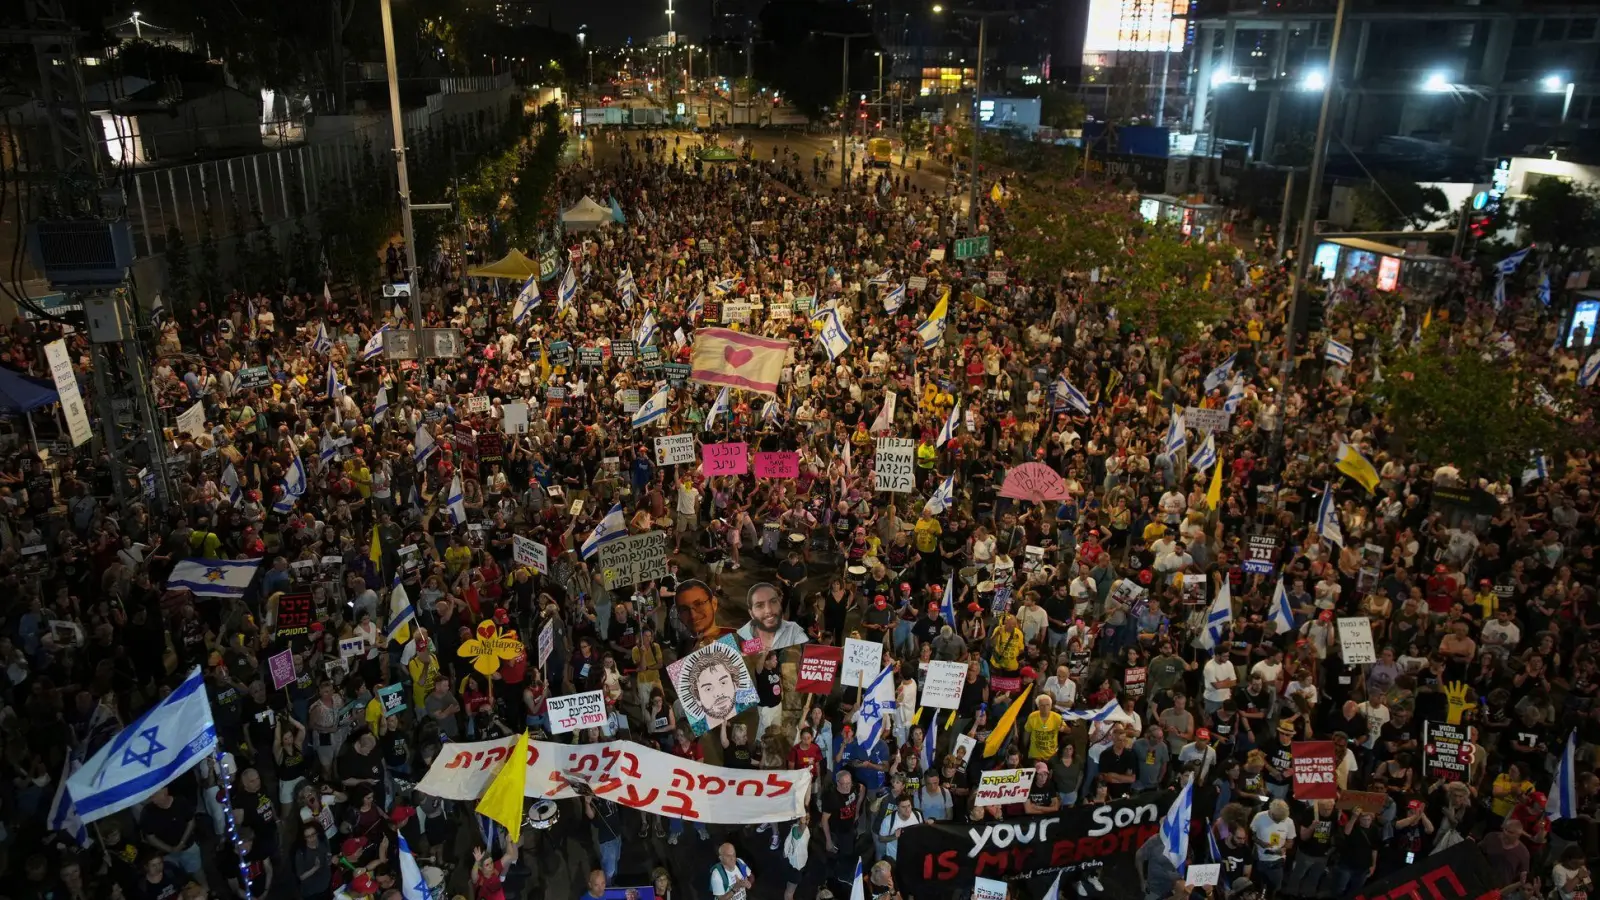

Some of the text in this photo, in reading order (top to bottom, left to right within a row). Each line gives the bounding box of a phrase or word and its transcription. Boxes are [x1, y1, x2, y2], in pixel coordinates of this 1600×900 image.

[1106, 161, 1142, 176] TOWR
[665, 437, 692, 446] הממשלה
[670, 445, 694, 453] הורגת
[712, 445, 741, 457] כולנו
[673, 453, 694, 462] אותנו
[877, 452, 911, 463] ממשלה
[713, 460, 736, 470] עינב
[764, 466, 792, 474] THE REST
[878, 463, 911, 475] בוגדת
[875, 475, 910, 489] בעמה
[1251, 536, 1275, 544] נתניהו
[602, 541, 626, 555] בשם
[1249, 548, 1272, 559] נגד
[517, 552, 545, 570] הביתה
[602, 554, 628, 568] החזרת
[639, 557, 666, 572] אותנו
[1244, 562, 1273, 573] ישראל
[640, 567, 667, 581] דרום
[277, 627, 308, 636] בחטופים
[469, 645, 493, 656] Pinta
[481, 638, 524, 653] Nattapong
[1343, 641, 1371, 651] קידוש
[801, 671, 833, 682] WAR
[549, 694, 602, 710] אומרים יחד ננצח
[568, 704, 601, 717] מצביעים
[558, 717, 578, 728] לבד
[1445, 731, 1464, 740] הצבאי
[1518, 732, 1538, 747] די
[568, 746, 642, 779] בלתי
[1294, 757, 1334, 765] END THIS
[1444, 761, 1465, 771] הצבאי
[1021, 771, 1034, 780] די
[1295, 772, 1334, 784] WAR
[671, 768, 793, 798] לחימה
[978, 786, 1019, 799] למלחמה
[1088, 803, 1158, 837] Son
[923, 850, 959, 880] IS
[975, 846, 1034, 877] MY
